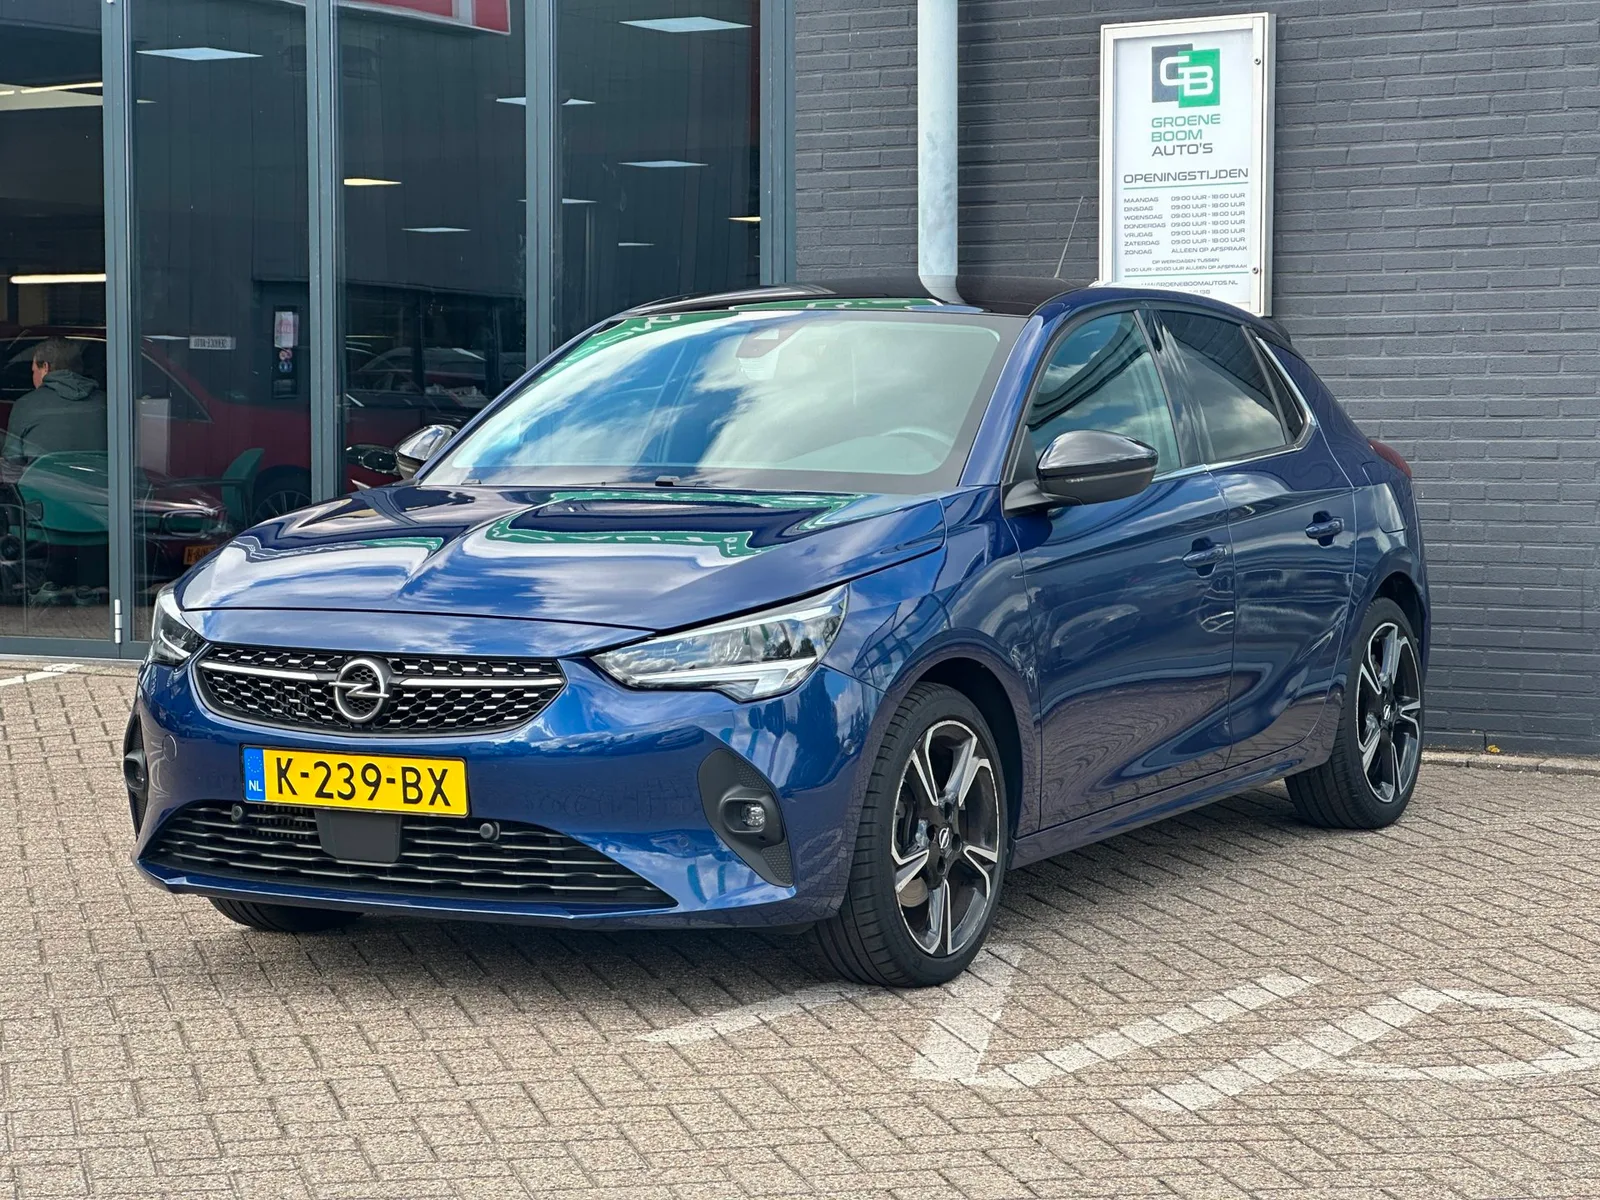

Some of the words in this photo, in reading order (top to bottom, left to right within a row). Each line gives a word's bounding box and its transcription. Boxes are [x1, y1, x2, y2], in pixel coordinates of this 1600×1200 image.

[1151, 113, 1221, 128] GROENE
[1151, 129, 1203, 142] BOOM
[1151, 142, 1213, 157] AUTO'S
[1123, 168, 1249, 184] OPENINGSTIJDEN
[248, 780, 263, 792] NL
[276, 757, 451, 807] K-239-BX
